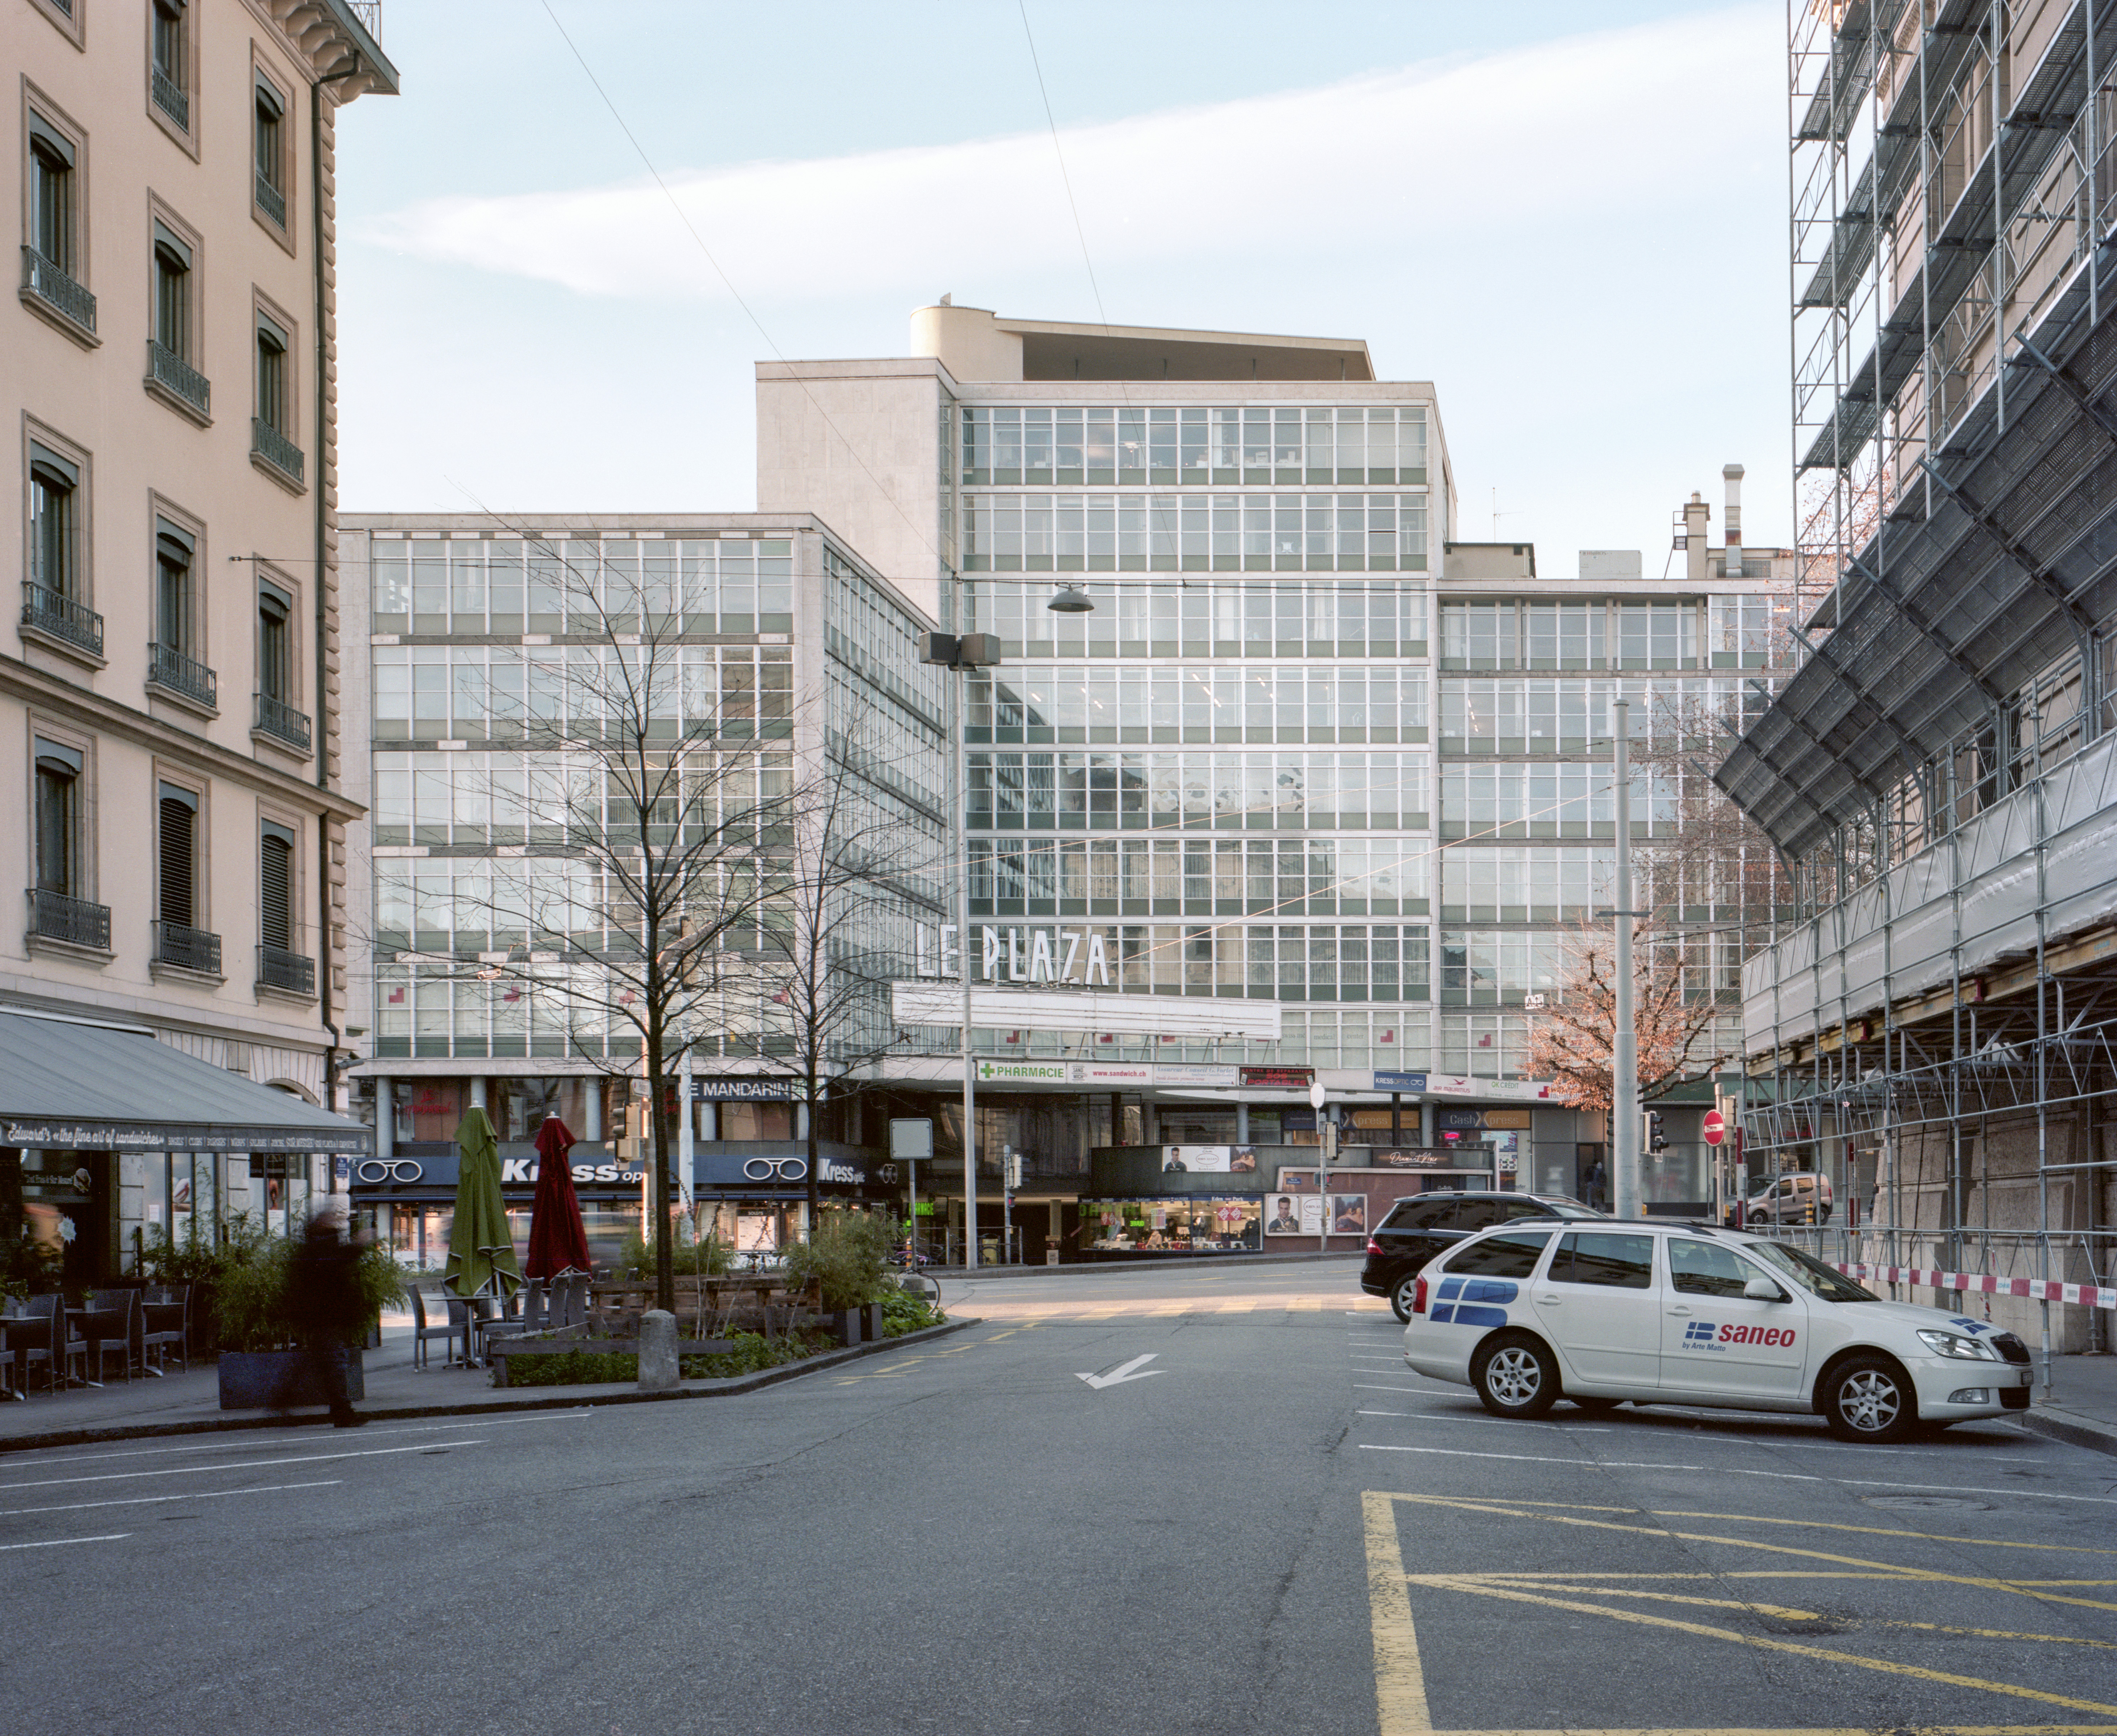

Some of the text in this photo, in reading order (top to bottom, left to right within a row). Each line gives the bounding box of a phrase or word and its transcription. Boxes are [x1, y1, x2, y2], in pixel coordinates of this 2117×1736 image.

[917, 923, 1109, 985] LE PLAZA
[997, 1066, 1064, 1078] PHARMACIE
[679, 1083, 788, 1096] E MANDARIN
[1450, 1111, 1518, 1127] CashXpress
[8, 1122, 51, 1141] Edward's
[73, 1127, 91, 1147] fine
[92, 1129, 105, 1143] art
[105, 1128, 115, 1148] of
[502, 1159, 619, 1181] Krss
[819, 1159, 854, 1182] Kress
[1682, 1341, 1689, 1350] by
[1718, 1324, 1796, 1347] saneo
